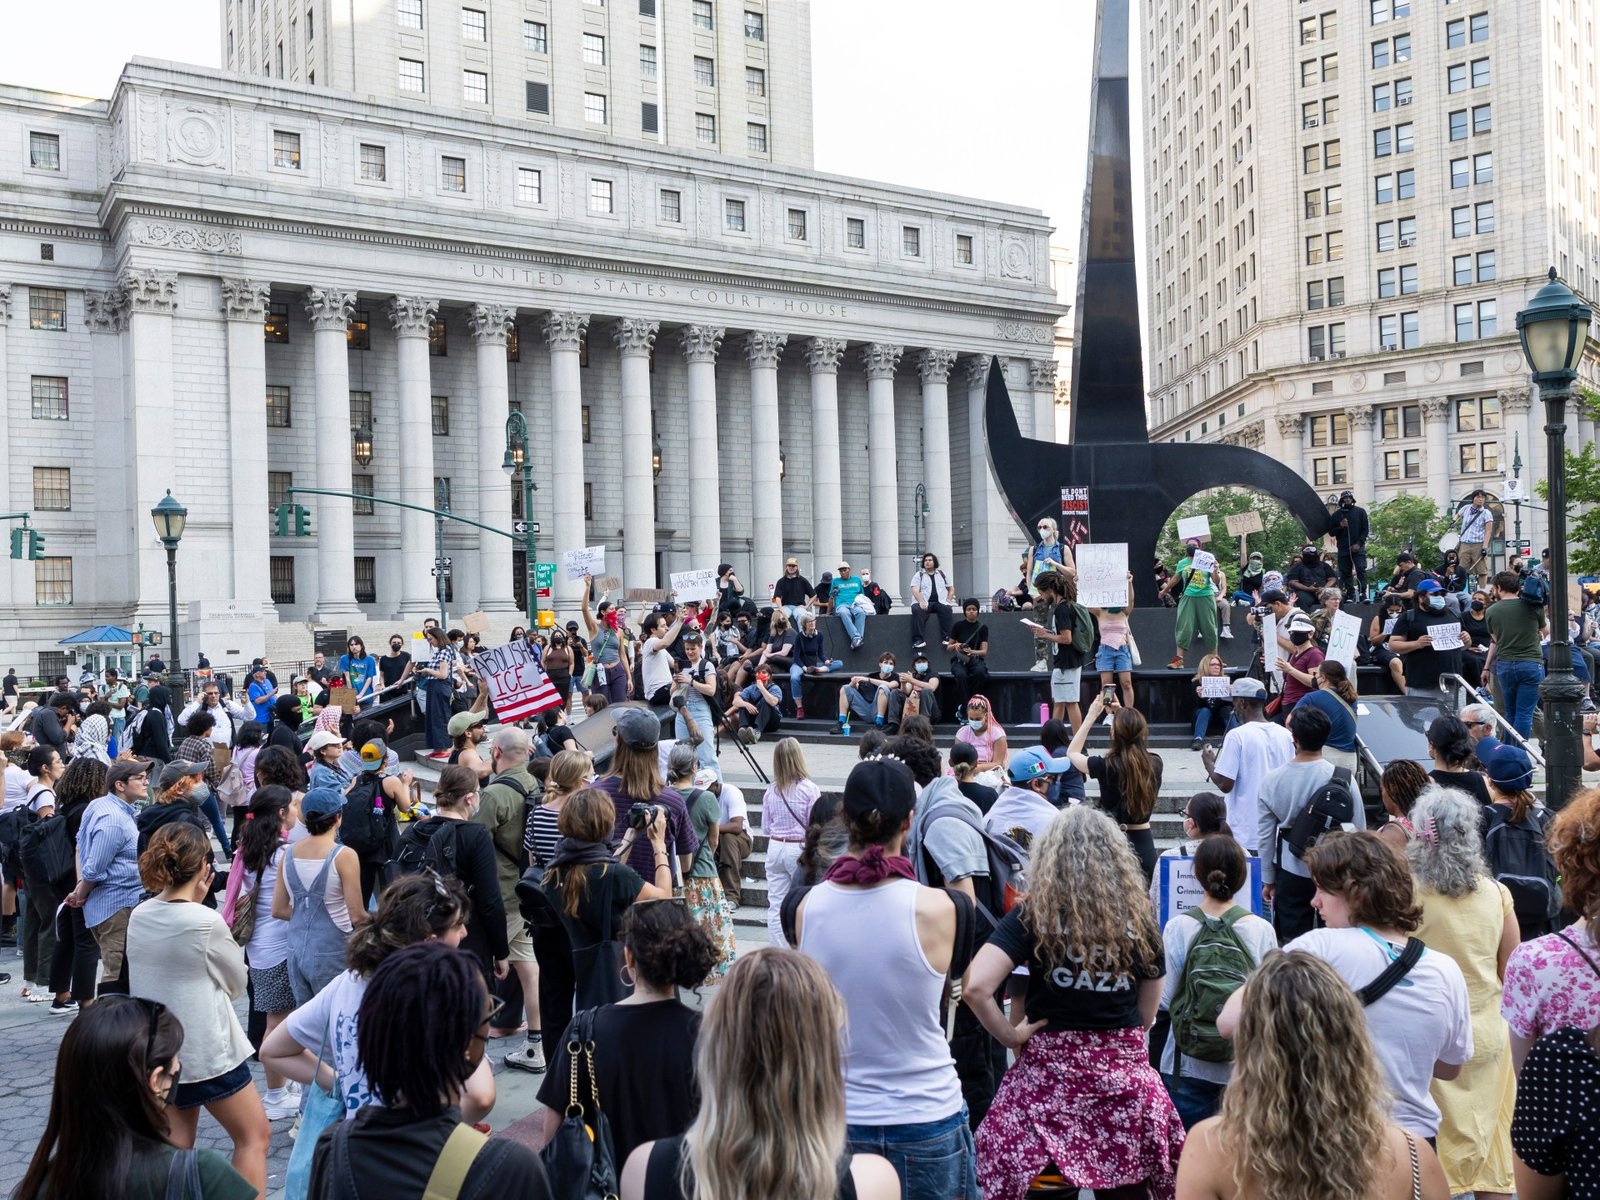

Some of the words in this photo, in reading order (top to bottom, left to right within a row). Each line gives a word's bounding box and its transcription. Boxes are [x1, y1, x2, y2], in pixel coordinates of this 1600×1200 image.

[473, 264, 563, 286] UNITED
[594, 278, 667, 297] STATES
[690, 289, 763, 308] COURT
[784, 299, 847, 317] HOUSE
[1061, 501, 1088, 511] FASCIST
[1232, 519, 1259, 534] ICE
[1429, 624, 1460, 636] ILLEGAL
[474, 641, 533, 680] ABOLISH
[492, 665, 532, 698] ICE
[1203, 677, 1229, 685] ILLEGAL
[1203, 688, 1229, 696] ALIENS
[1052, 966, 1131, 992] GAZA
